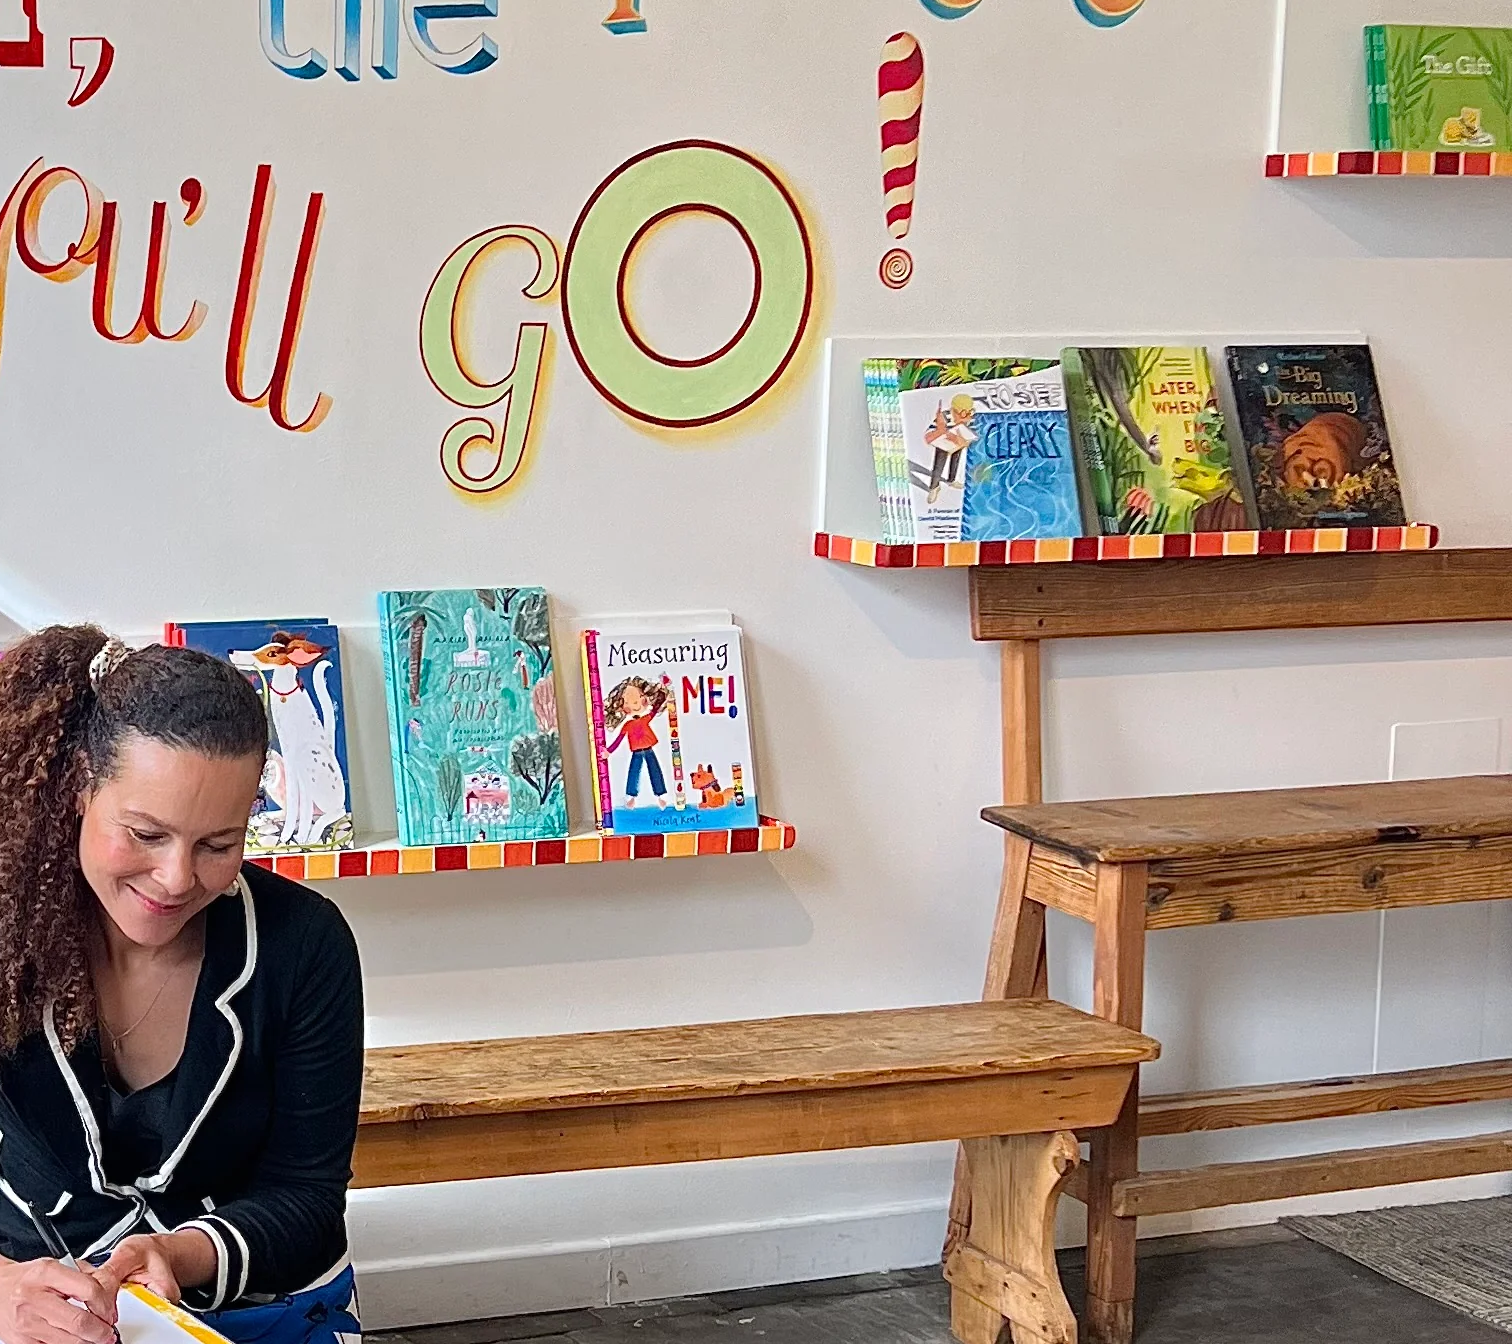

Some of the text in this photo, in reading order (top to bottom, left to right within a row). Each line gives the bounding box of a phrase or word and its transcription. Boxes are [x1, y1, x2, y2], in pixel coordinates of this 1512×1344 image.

[1294, 366, 1323, 389] Big
[975, 382, 1062, 410] TO SEE
[1152, 401, 1201, 414] WHEN
[1262, 385, 1358, 413] Dreaming
[984, 422, 1061, 458] CLEARLY
[1184, 440, 1212, 453] BIG
[607, 638, 728, 671] Measuring
[681, 675, 738, 719] ME!
[449, 700, 499, 723] RUNS
